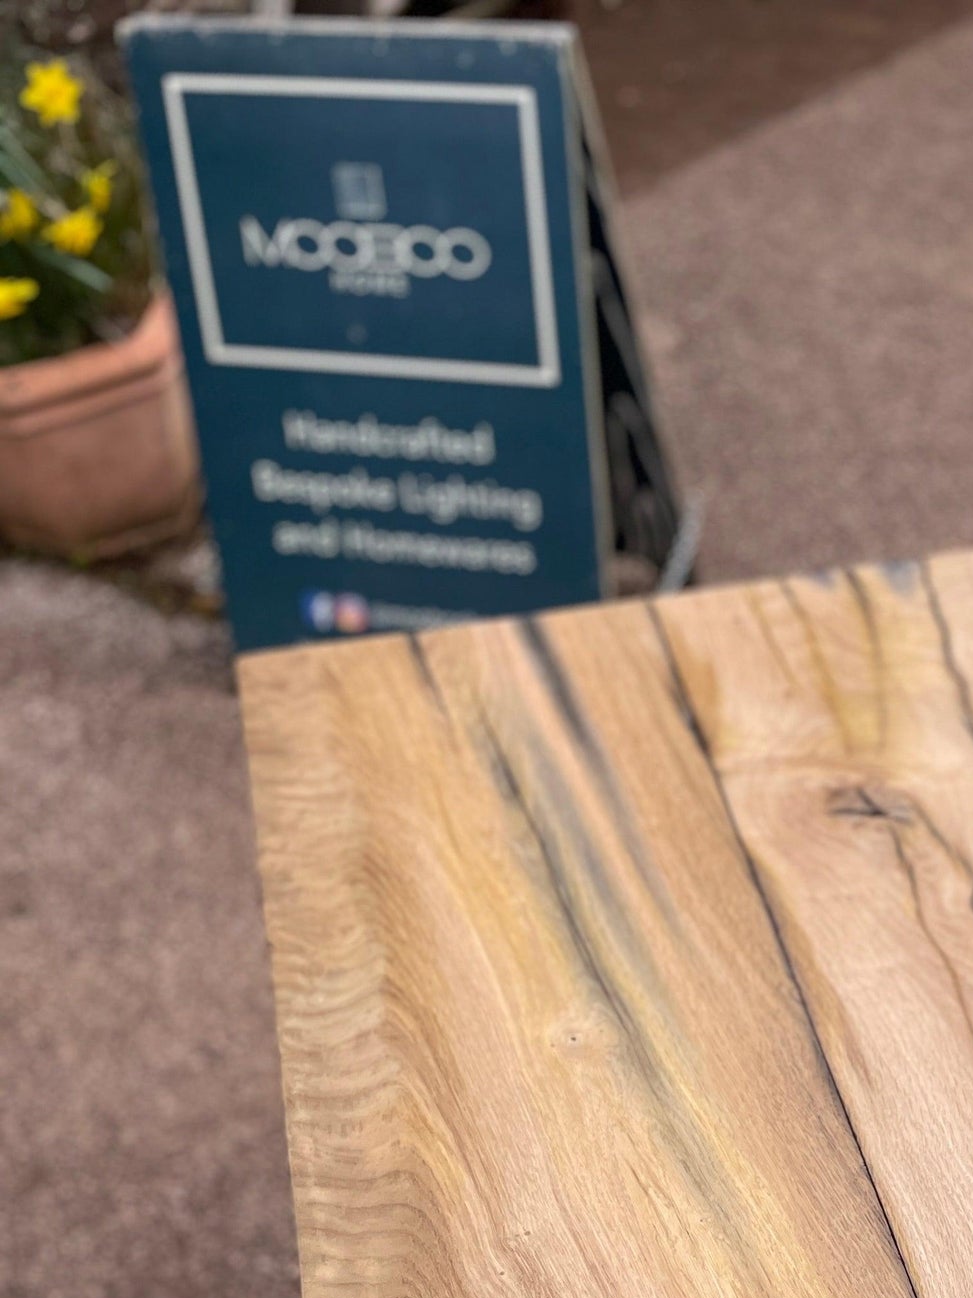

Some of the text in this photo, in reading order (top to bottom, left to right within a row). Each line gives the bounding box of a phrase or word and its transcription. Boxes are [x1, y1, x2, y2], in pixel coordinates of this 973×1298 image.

[283, 409, 495, 465] Handcrafted
[252, 459, 543, 531] Bespoke Lighting
[273, 517, 537, 576] and Homewares
